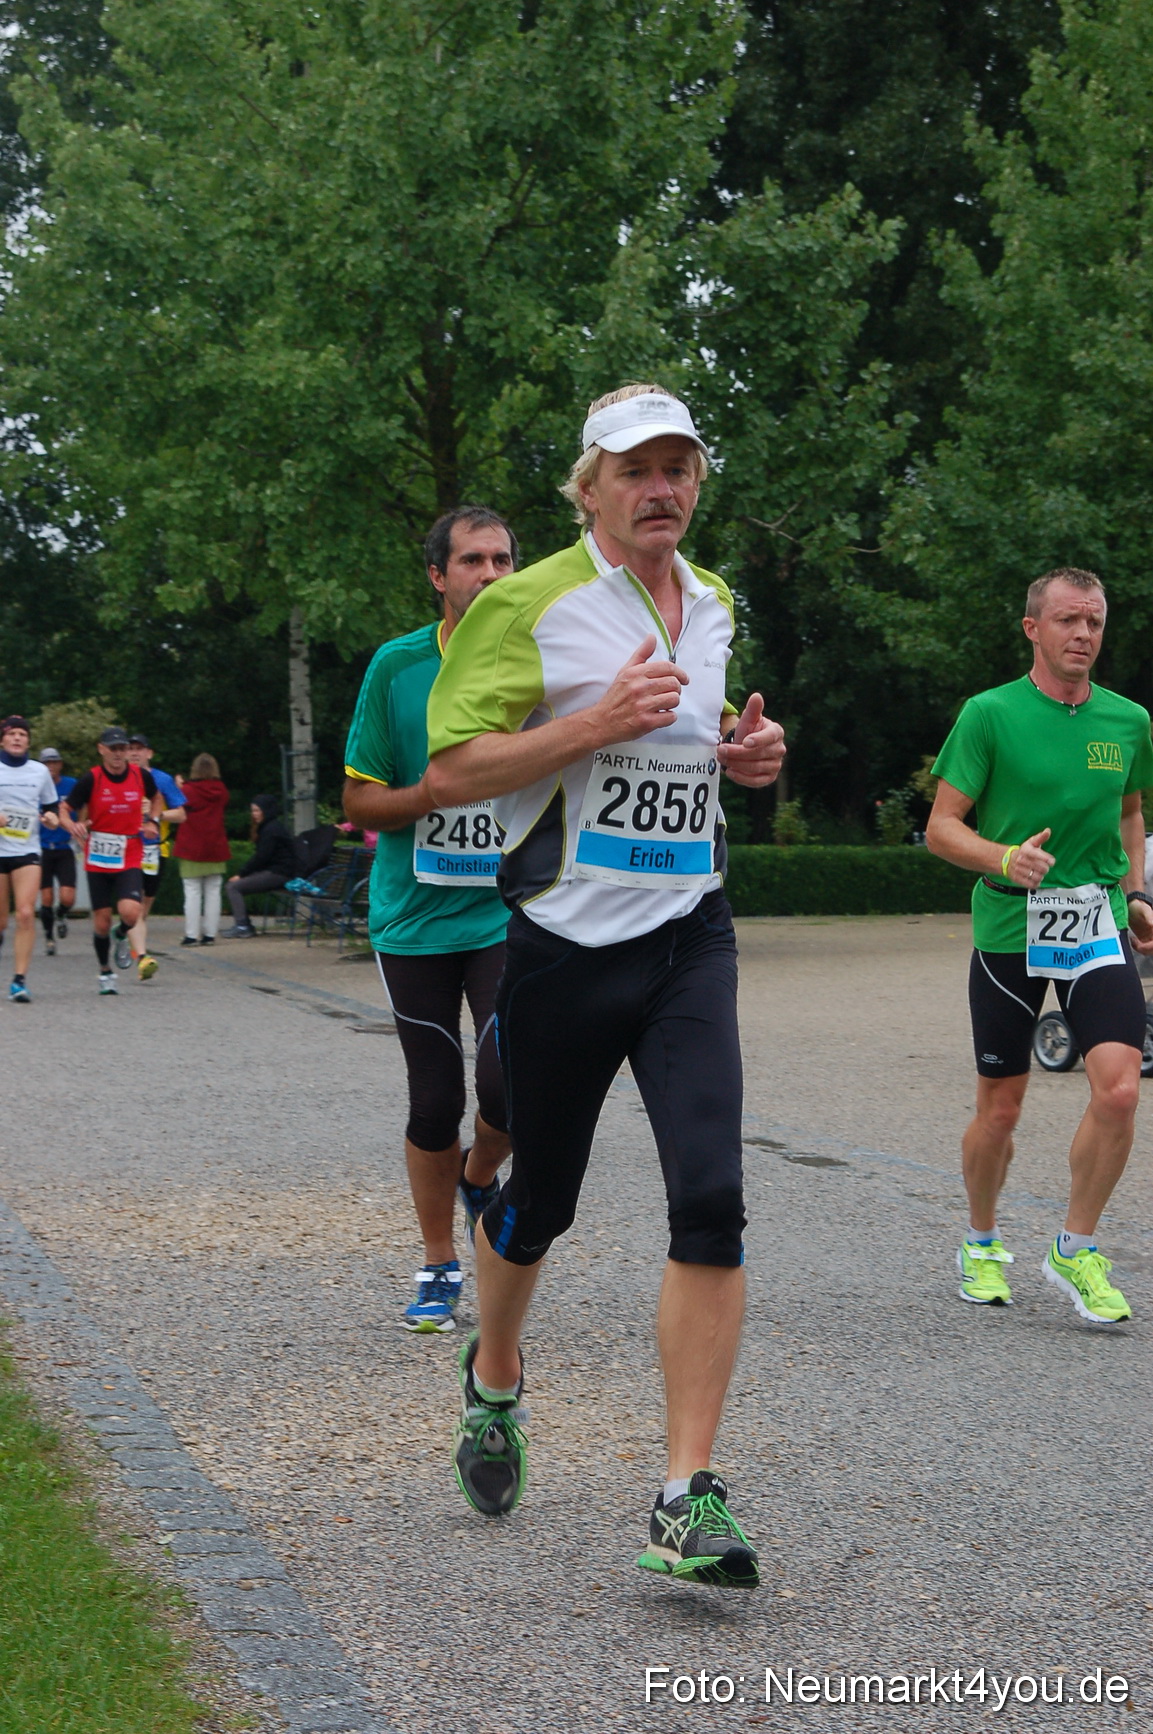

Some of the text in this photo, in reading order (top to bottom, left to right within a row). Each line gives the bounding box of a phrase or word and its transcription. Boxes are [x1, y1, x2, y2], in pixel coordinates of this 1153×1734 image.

[594, 752, 706, 774] PARTL Neumarkt
[1087, 742, 1123, 767] SVA
[596, 776, 710, 834] 2858
[584, 820, 591, 829] B
[437, 857, 500, 873] Christian
[629, 846, 675, 868] Erich
[1030, 896, 1064, 905] PARTL
